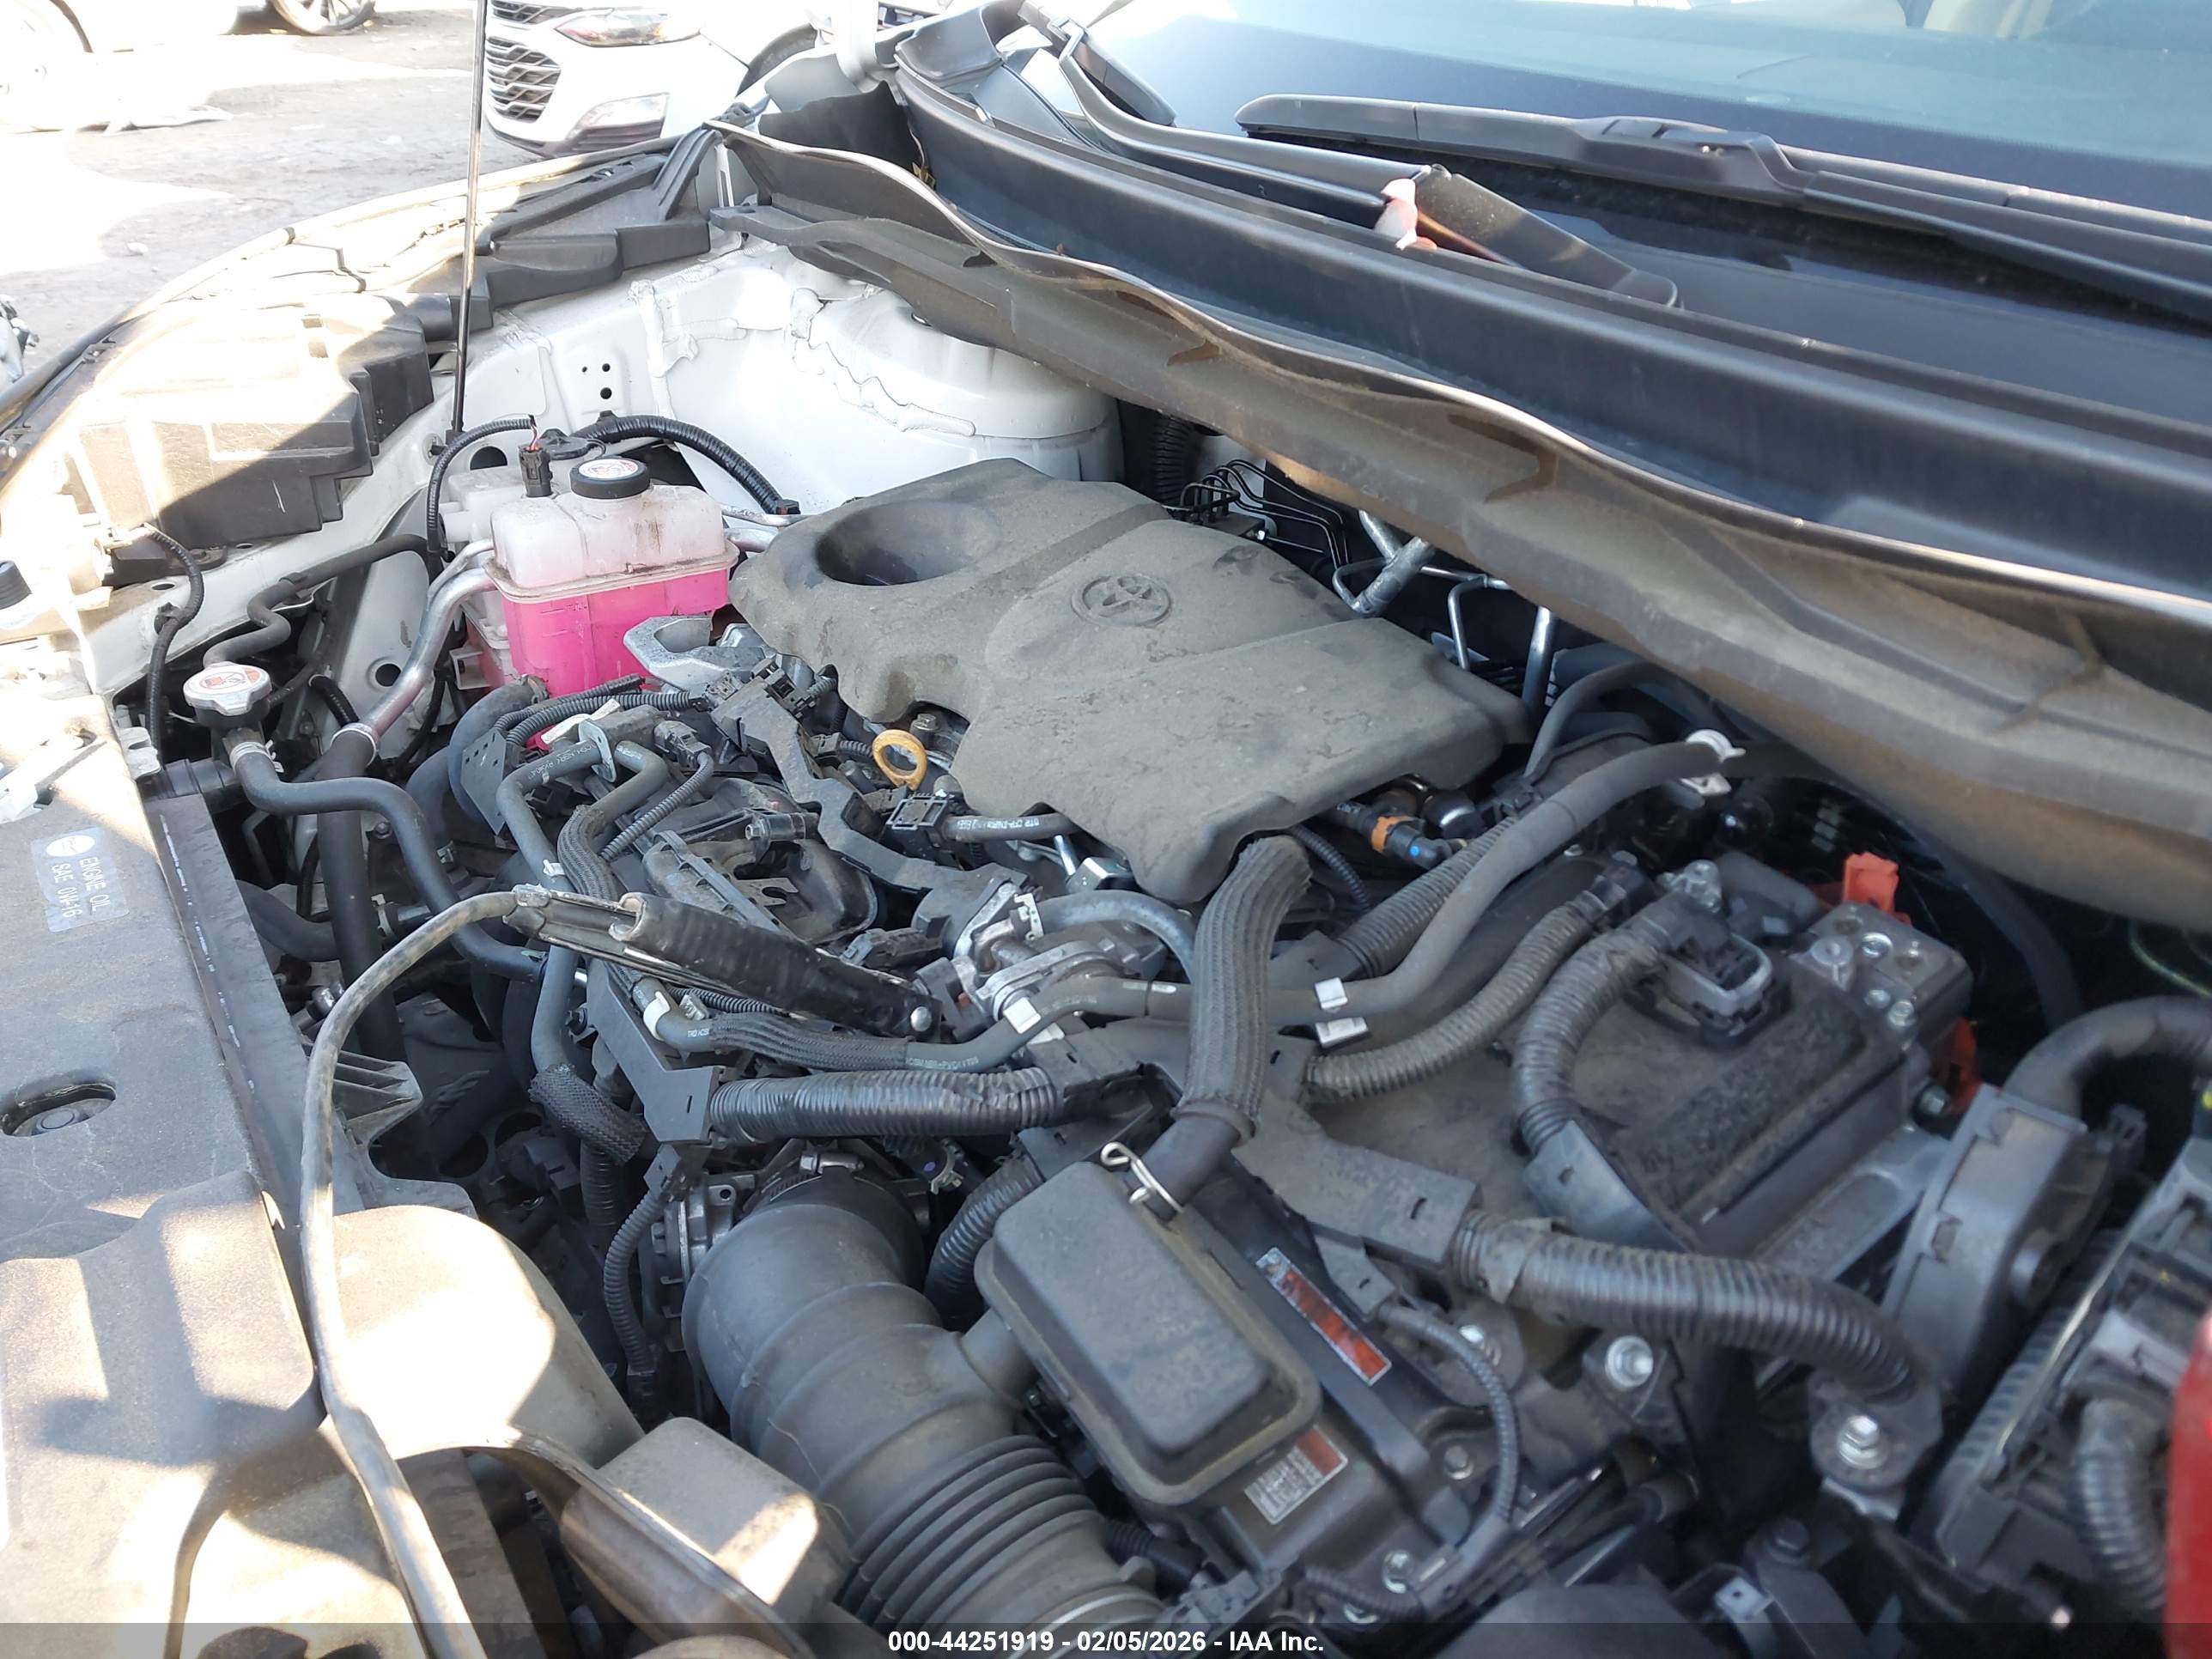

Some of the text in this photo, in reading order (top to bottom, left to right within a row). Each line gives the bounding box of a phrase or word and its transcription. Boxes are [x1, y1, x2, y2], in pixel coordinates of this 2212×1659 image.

[52, 863, 74, 883] SAE
[79, 857, 110, 912] ENGINE OIL
[58, 887, 83, 918] 0W-16
